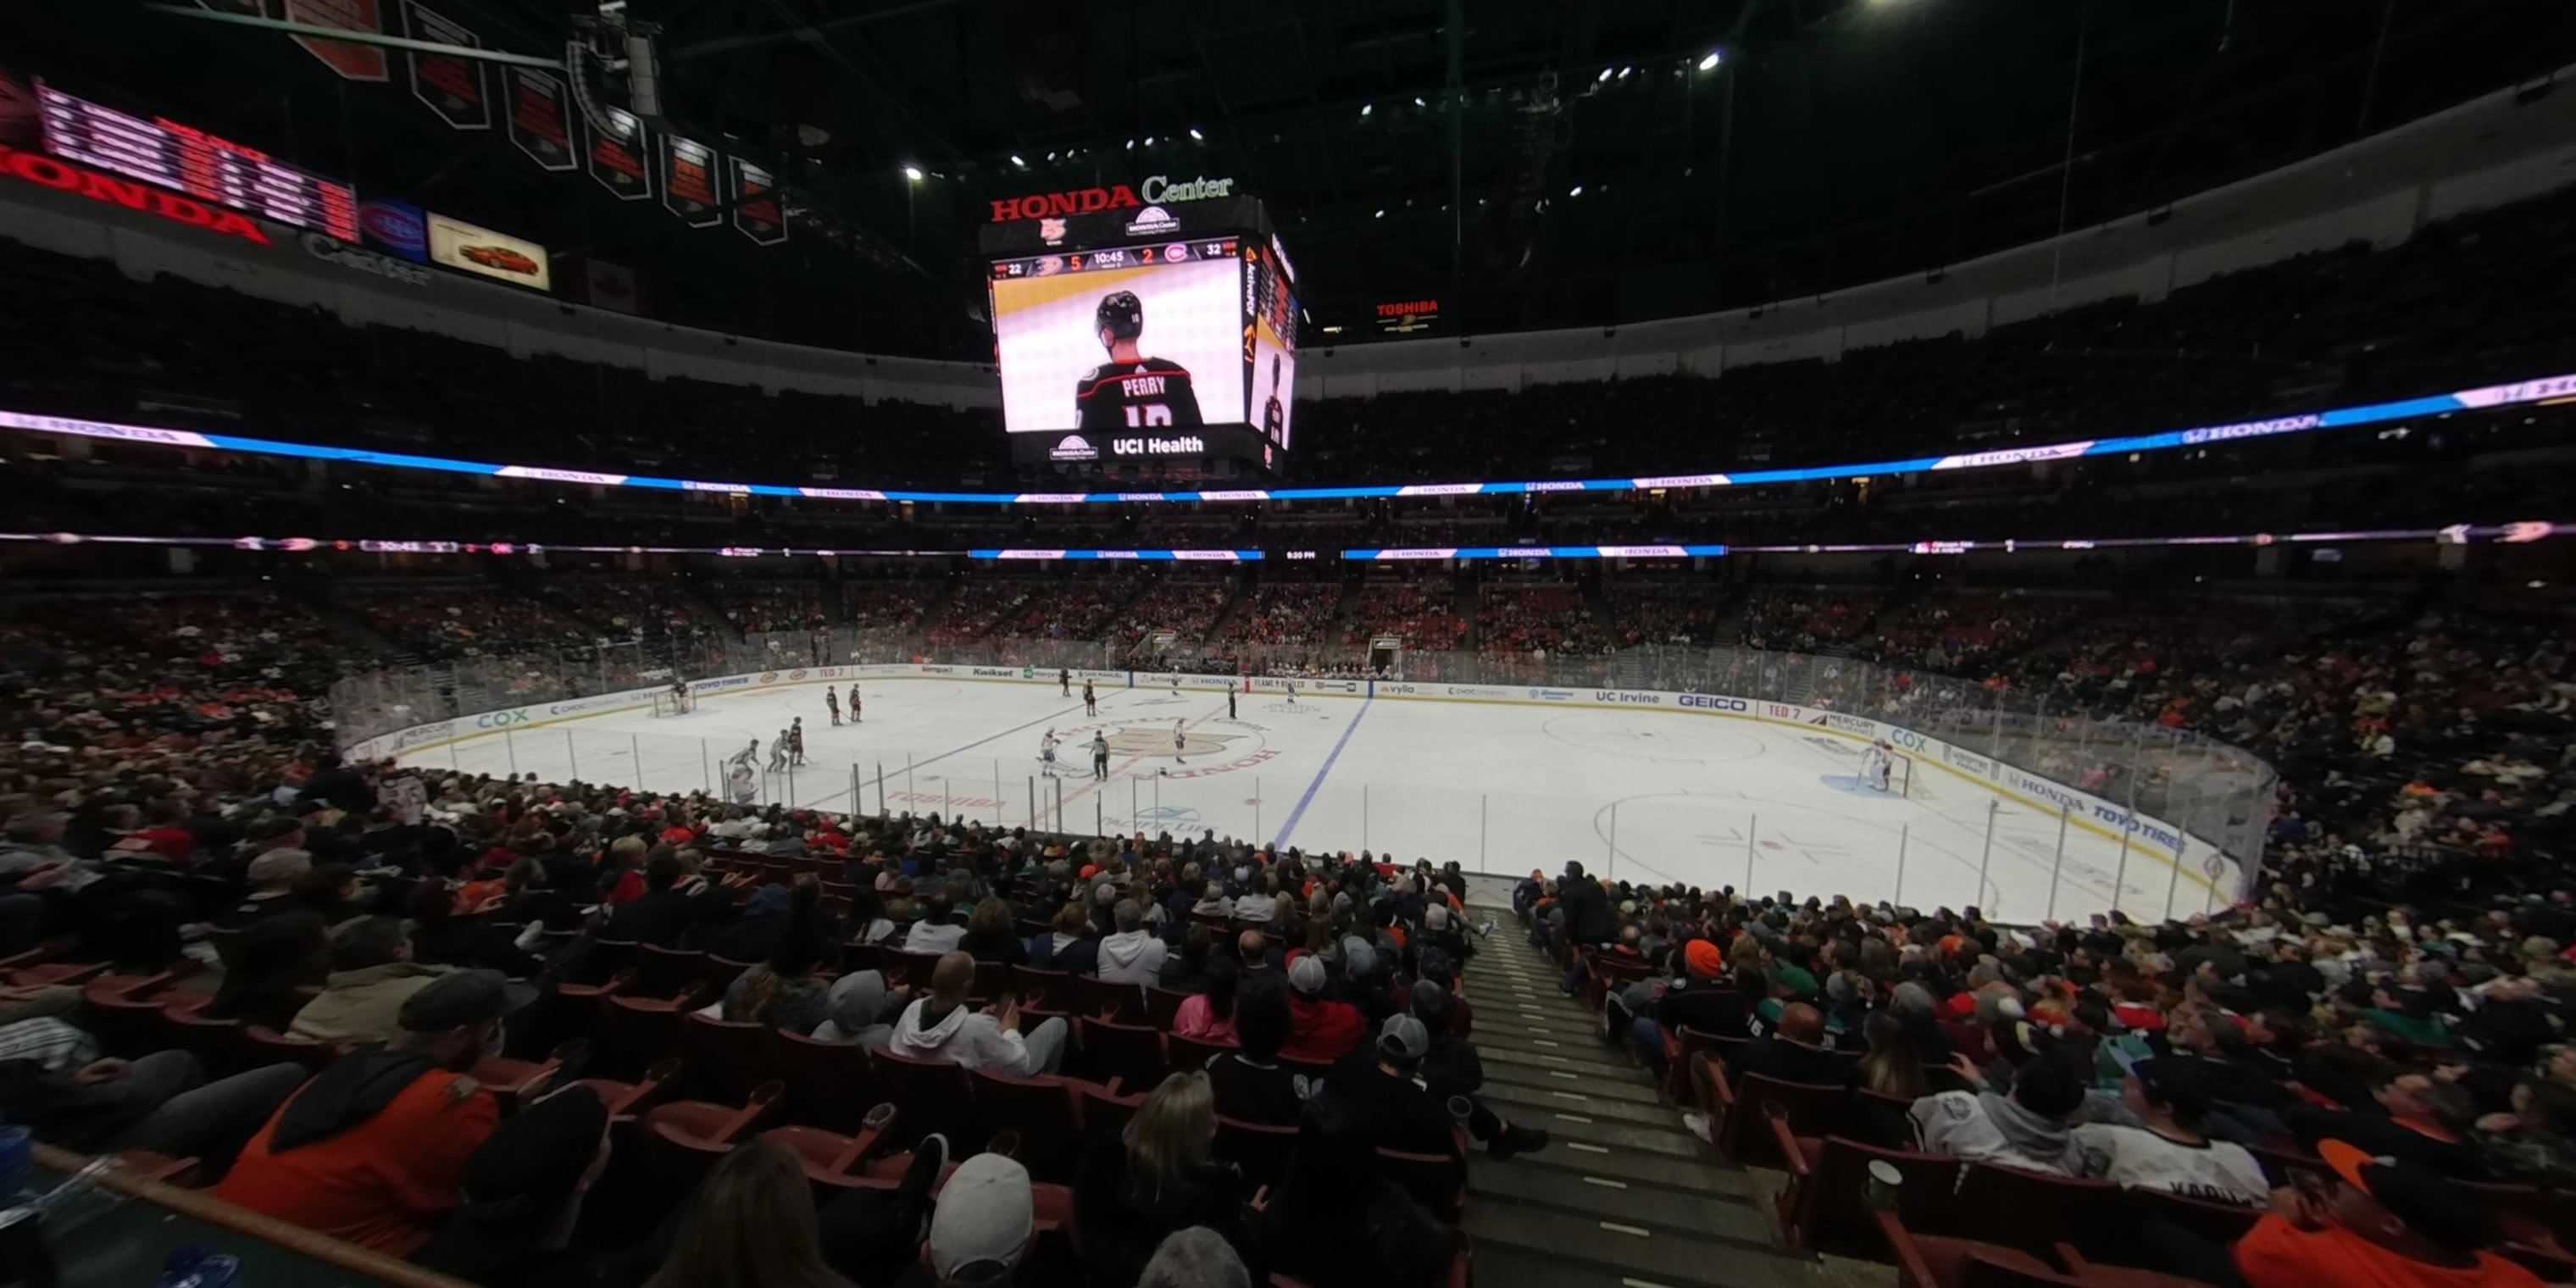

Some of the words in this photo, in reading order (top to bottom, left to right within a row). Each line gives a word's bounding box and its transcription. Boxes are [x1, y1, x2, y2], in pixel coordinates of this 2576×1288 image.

[0, 144, 273, 247] ONDA
[991, 186, 1139, 222] HONDA
[1141, 175, 1234, 204] Center
[1141, 249, 1153, 263] 2
[1207, 243, 1221, 256] 32
[1070, 256, 1081, 271] 5
[1094, 251, 1124, 264] 10:45
[1008, 264, 1022, 275] 22
[1376, 300, 1439, 316] TOSHIBA
[1122, 377, 1166, 397] PERRY
[49, 419, 180, 441] HONDA
[2210, 414, 2320, 439] HONDA
[1113, 439, 1144, 454] UCI
[1147, 436, 1204, 454] Health
[1979, 449, 2062, 464] HONDA
[541, 471, 605, 482] HONDA
[1660, 476, 1713, 486] HONDA
[696, 482, 752, 492] HONDA
[1423, 486, 1468, 494] HONDA
[1536, 481, 1585, 491] HONDA
[825, 490, 872, 498] HONDA
[1127, 492, 1163, 501] HONDA
[1508, 548, 1552, 557] HONDA
[1624, 547, 1669, 555] HONDA
[973, 668, 1013, 677] Kwikset
[694, 680, 720, 691] TOYO
[721, 676, 749, 687] TIRES
[1390, 684, 1414, 695] vylla
[1596, 691, 1615, 702] UC
[1619, 692, 1660, 703] Irvine
[1678, 695, 1747, 711] GEICO
[476, 708, 530, 729] COX
[1768, 705, 1790, 719] TED
[1792, 708, 1802, 719] 7
[1891, 729, 1927, 753] COX
[887, 791, 1007, 808] TOSHIBA
[2021, 779, 2085, 812] HONDA
[1100, 816, 1176, 830] PACIFIC
[2093, 804, 2140, 833] TOYO
[2141, 824, 2186, 854] TIRES
